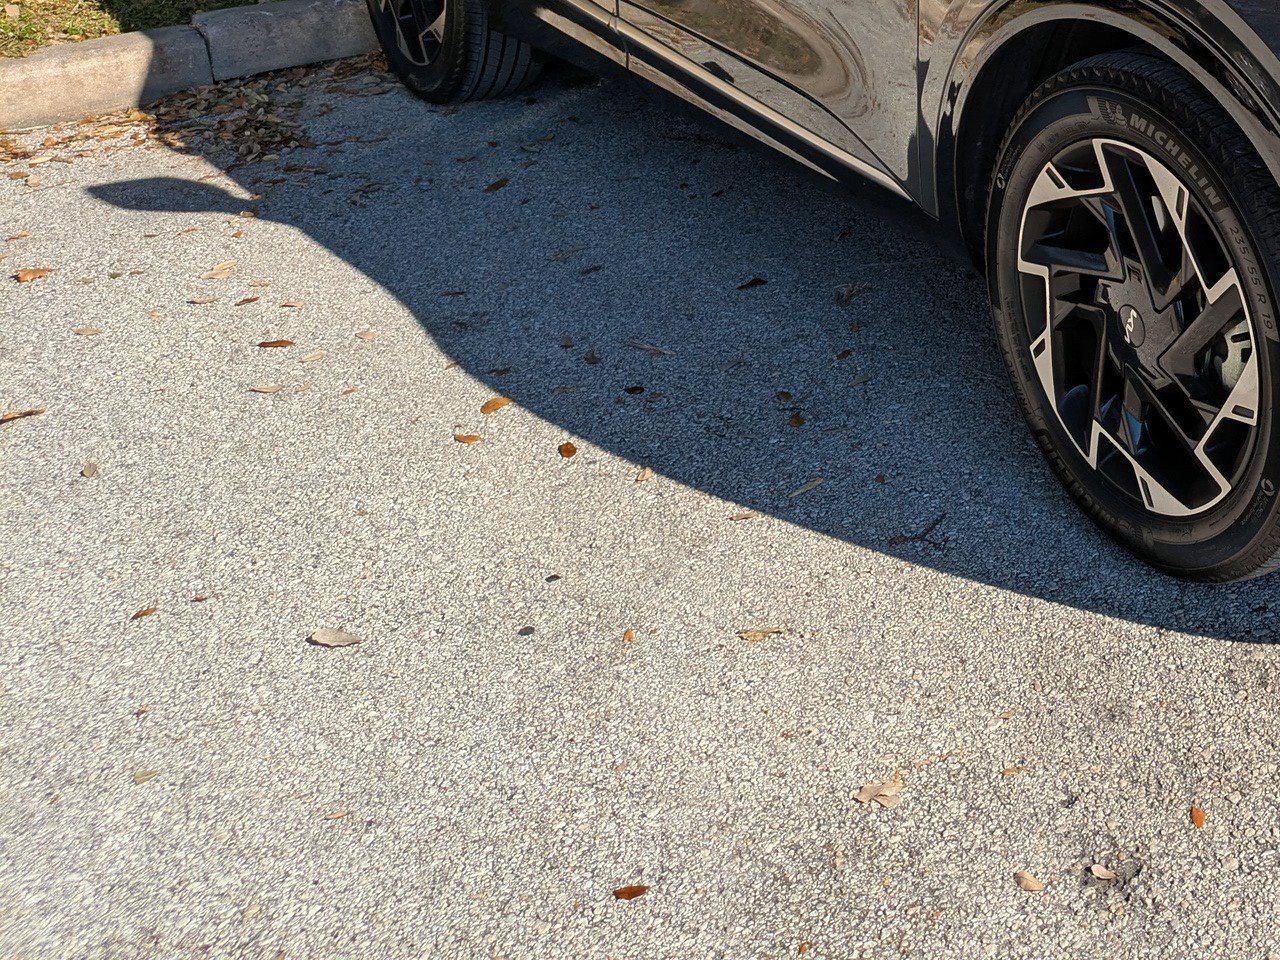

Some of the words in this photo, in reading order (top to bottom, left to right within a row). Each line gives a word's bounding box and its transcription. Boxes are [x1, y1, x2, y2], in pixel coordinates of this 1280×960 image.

[1129, 112, 1223, 207] MICHELIN
[1228, 225, 1263, 287] 235/55
[1256, 292, 1267, 305] R
[1262, 311, 1275, 331] 19
